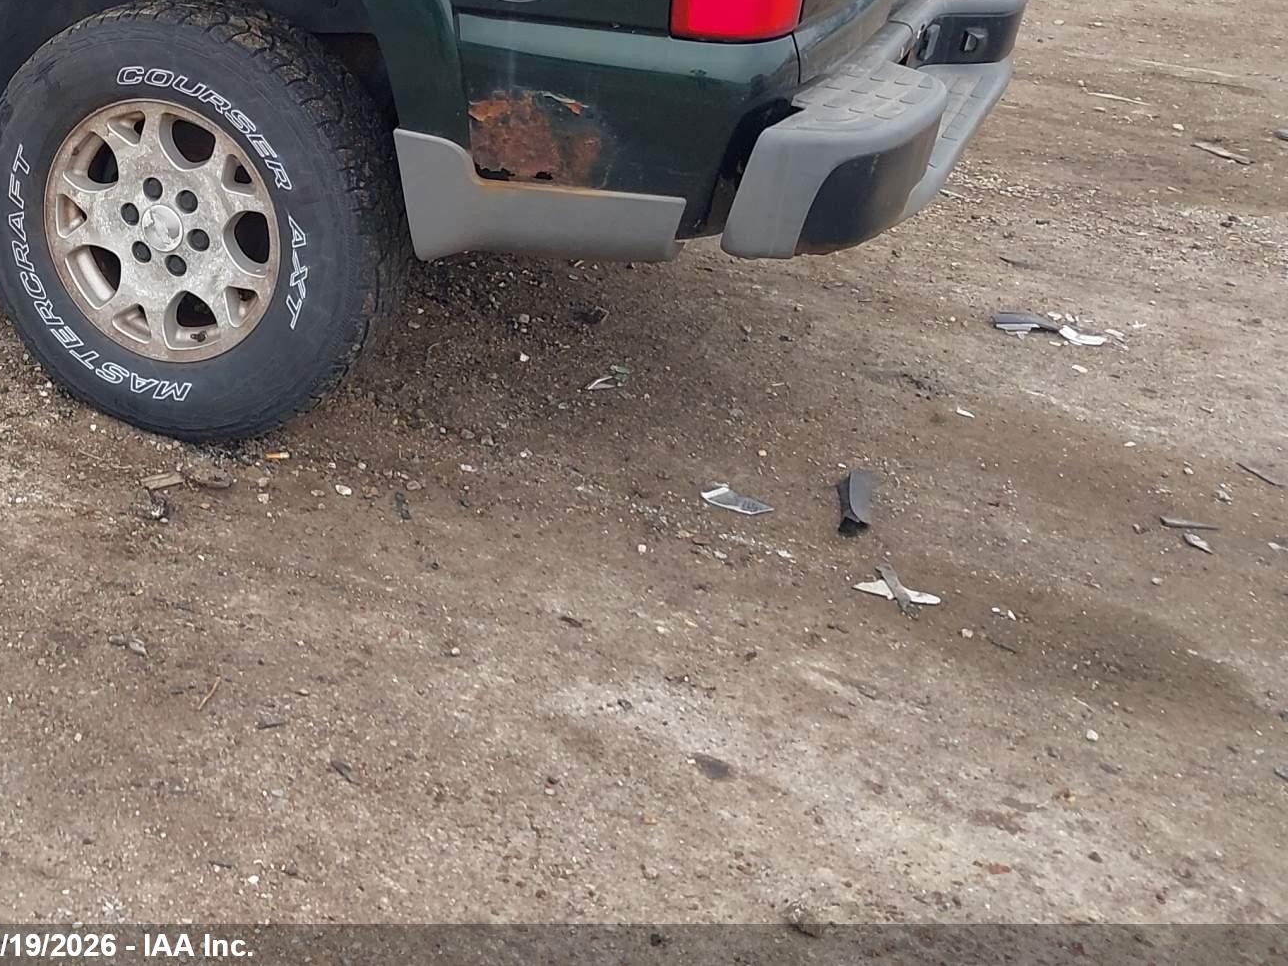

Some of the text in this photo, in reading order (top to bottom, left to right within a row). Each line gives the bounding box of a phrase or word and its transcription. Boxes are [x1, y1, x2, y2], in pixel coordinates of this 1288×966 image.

[8, 144, 192, 401] MASTERCRAFT
[116, 66, 308, 330] COURSER AXT
